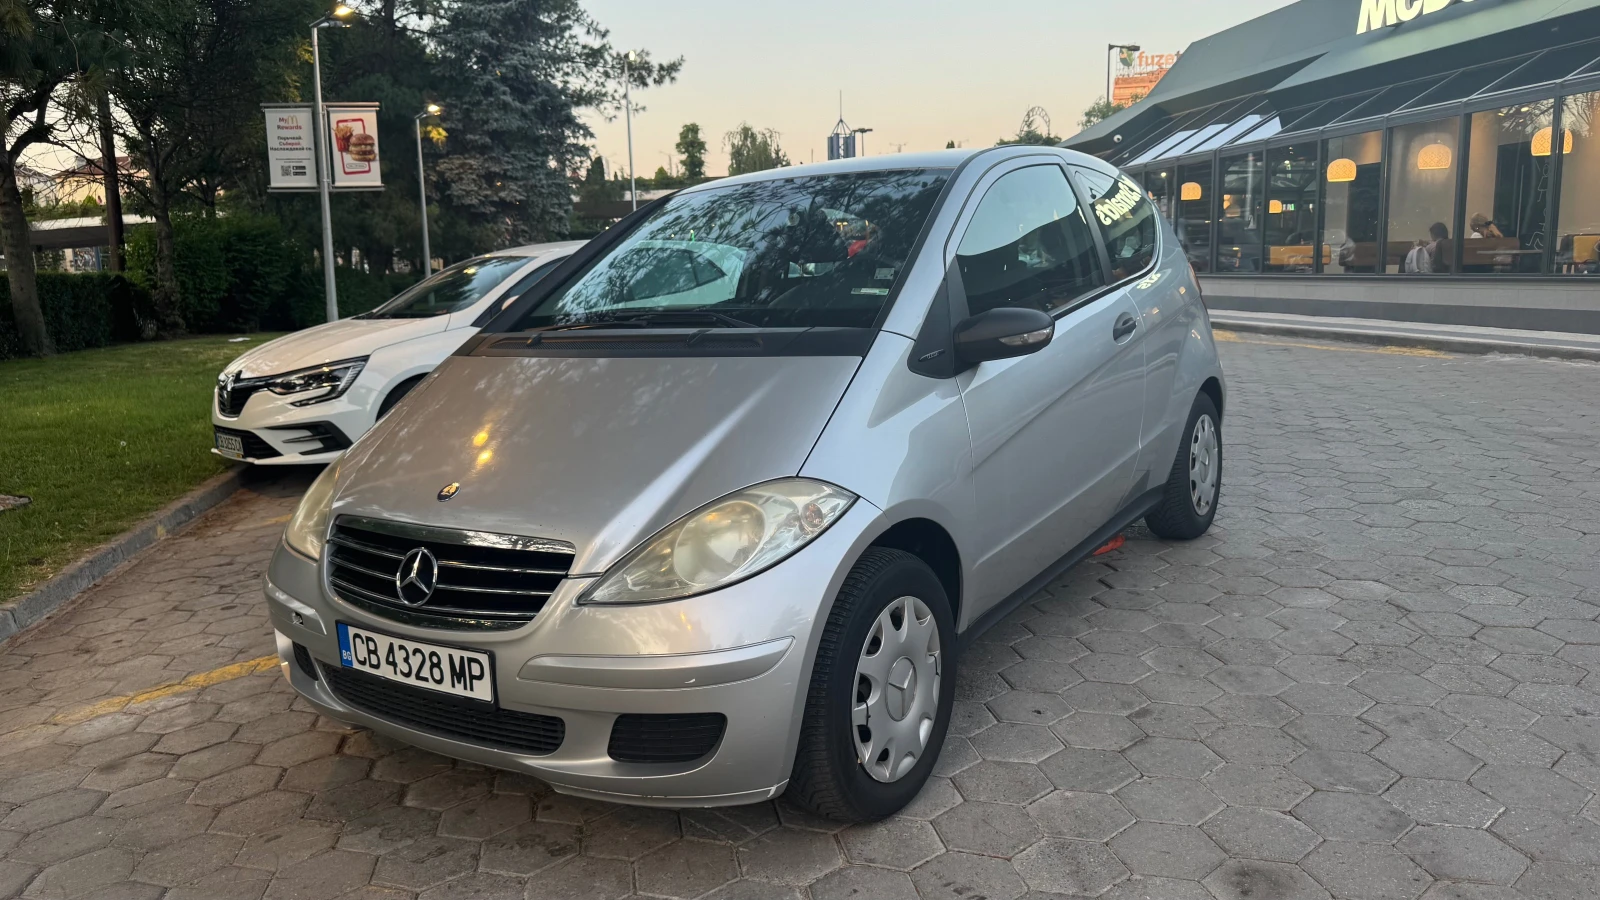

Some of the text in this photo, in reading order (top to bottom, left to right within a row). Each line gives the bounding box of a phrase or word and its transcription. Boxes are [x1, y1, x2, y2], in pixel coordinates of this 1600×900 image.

[1356, 0, 1474, 35] Mc
[342, 649, 352, 661] BG
[352, 632, 485, 692] CB 4328 MP
